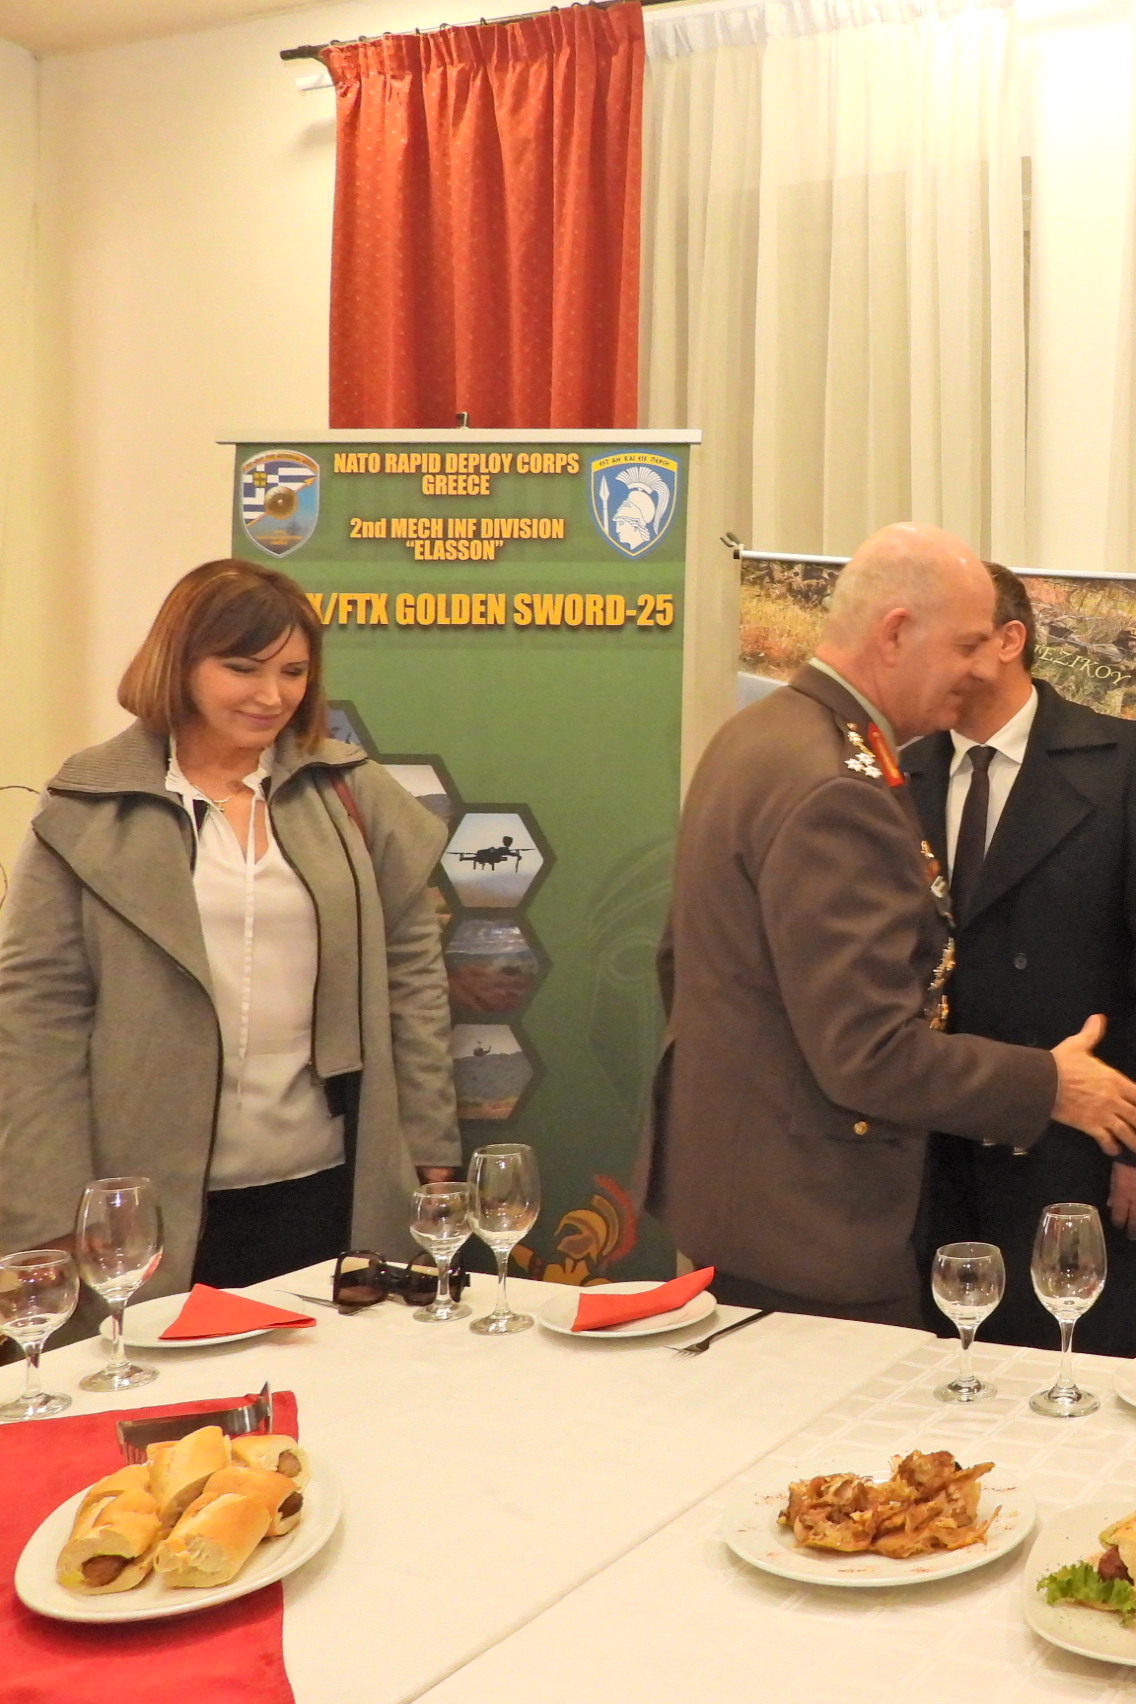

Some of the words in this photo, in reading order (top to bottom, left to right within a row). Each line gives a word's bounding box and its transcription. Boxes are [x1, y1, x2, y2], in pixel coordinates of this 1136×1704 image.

[334, 453, 381, 474] NATO
[385, 453, 442, 474] RAPID
[446, 453, 513, 474] DEPLOY
[516, 453, 580, 474] CORPS
[422, 475, 490, 496] GREECE
[350, 517, 387, 539] 2nd
[391, 518, 444, 539] MECH
[448, 518, 477, 539] INF
[481, 518, 564, 539] DIVISION
[406, 539, 503, 561] “ELASSON”
[395, 592, 506, 625] GOLDEN
[513, 592, 674, 626] SWORD-25
